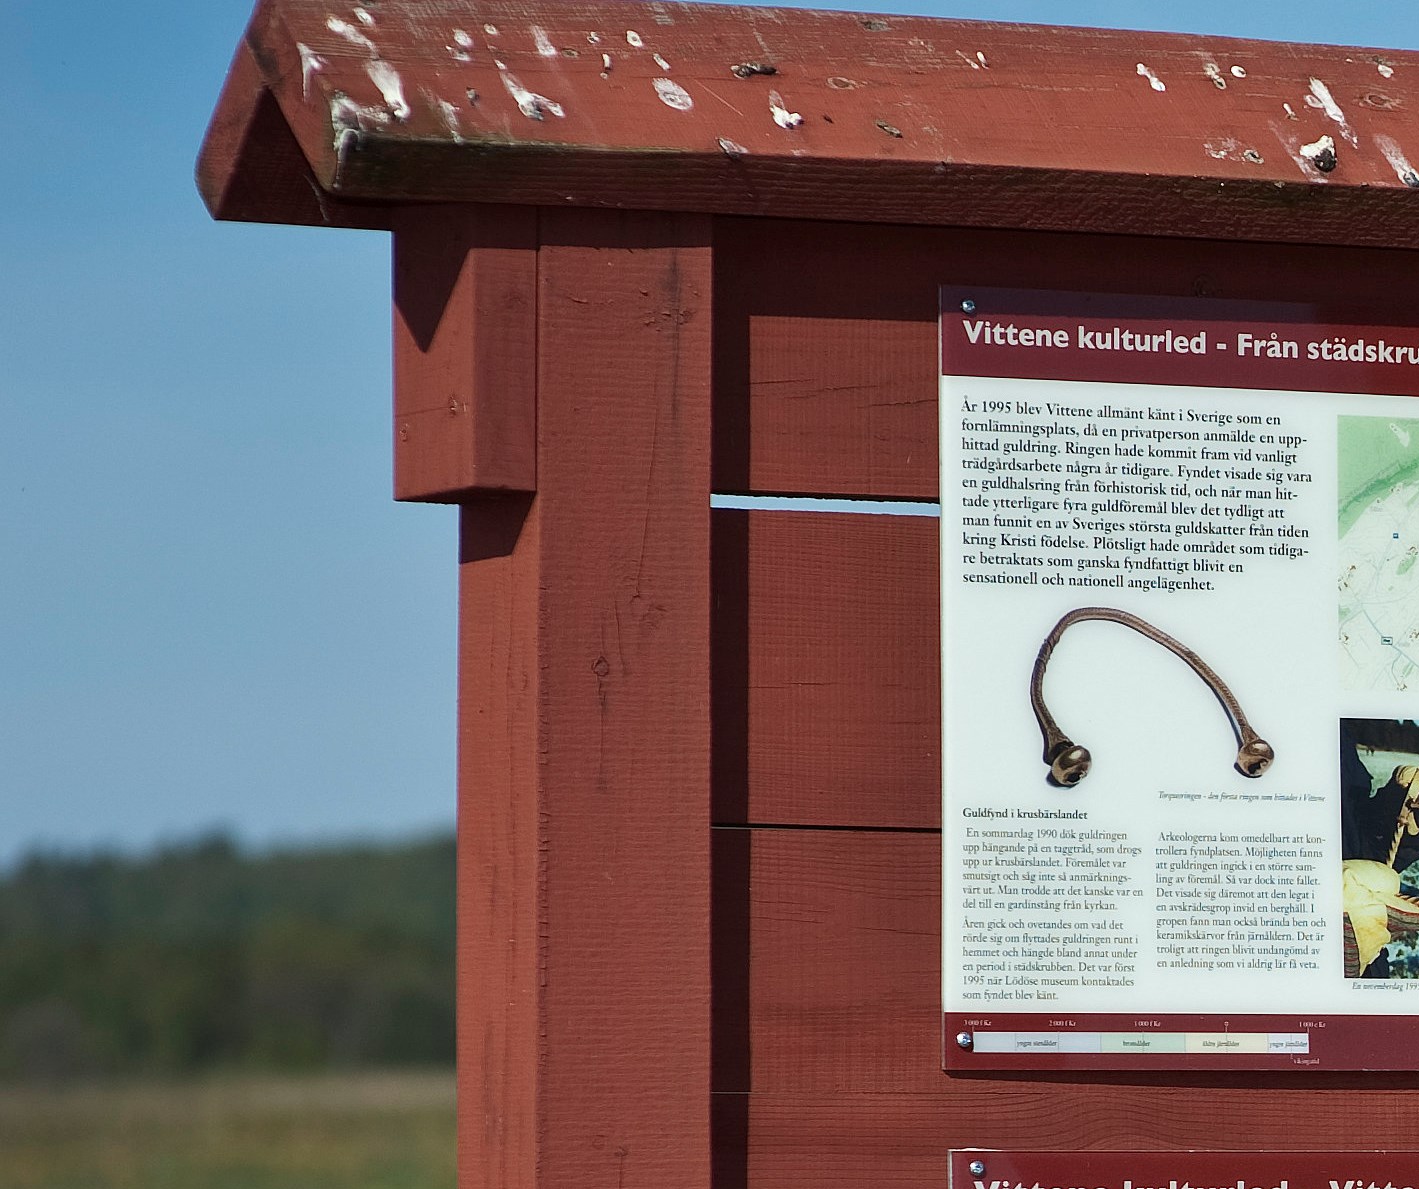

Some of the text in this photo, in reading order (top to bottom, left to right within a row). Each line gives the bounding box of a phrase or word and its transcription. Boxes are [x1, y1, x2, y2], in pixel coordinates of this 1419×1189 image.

[962, 319, 1069, 347] Vittene
[1078, 325, 1206, 354] kulturled
[1237, 333, 1298, 358] Från
[960, 395, 1280, 427] År 1995 blev Vittene allmänt känt i Sverige som en
[961, 417, 1307, 448] fornlämningsplats, då en privatperson anmälde en upp-
[961, 436, 1296, 466] hittad guldring. Ringen hade kommit fram vid vanligt
[961, 456, 1311, 485] trädgårdsarbete några år tidigare. Fyndet visade sig vara
[962, 807, 1087, 820] Guldfynd i krusbärslandet
[965, 827, 1127, 842] En sommardag 1990 dök guldringen
